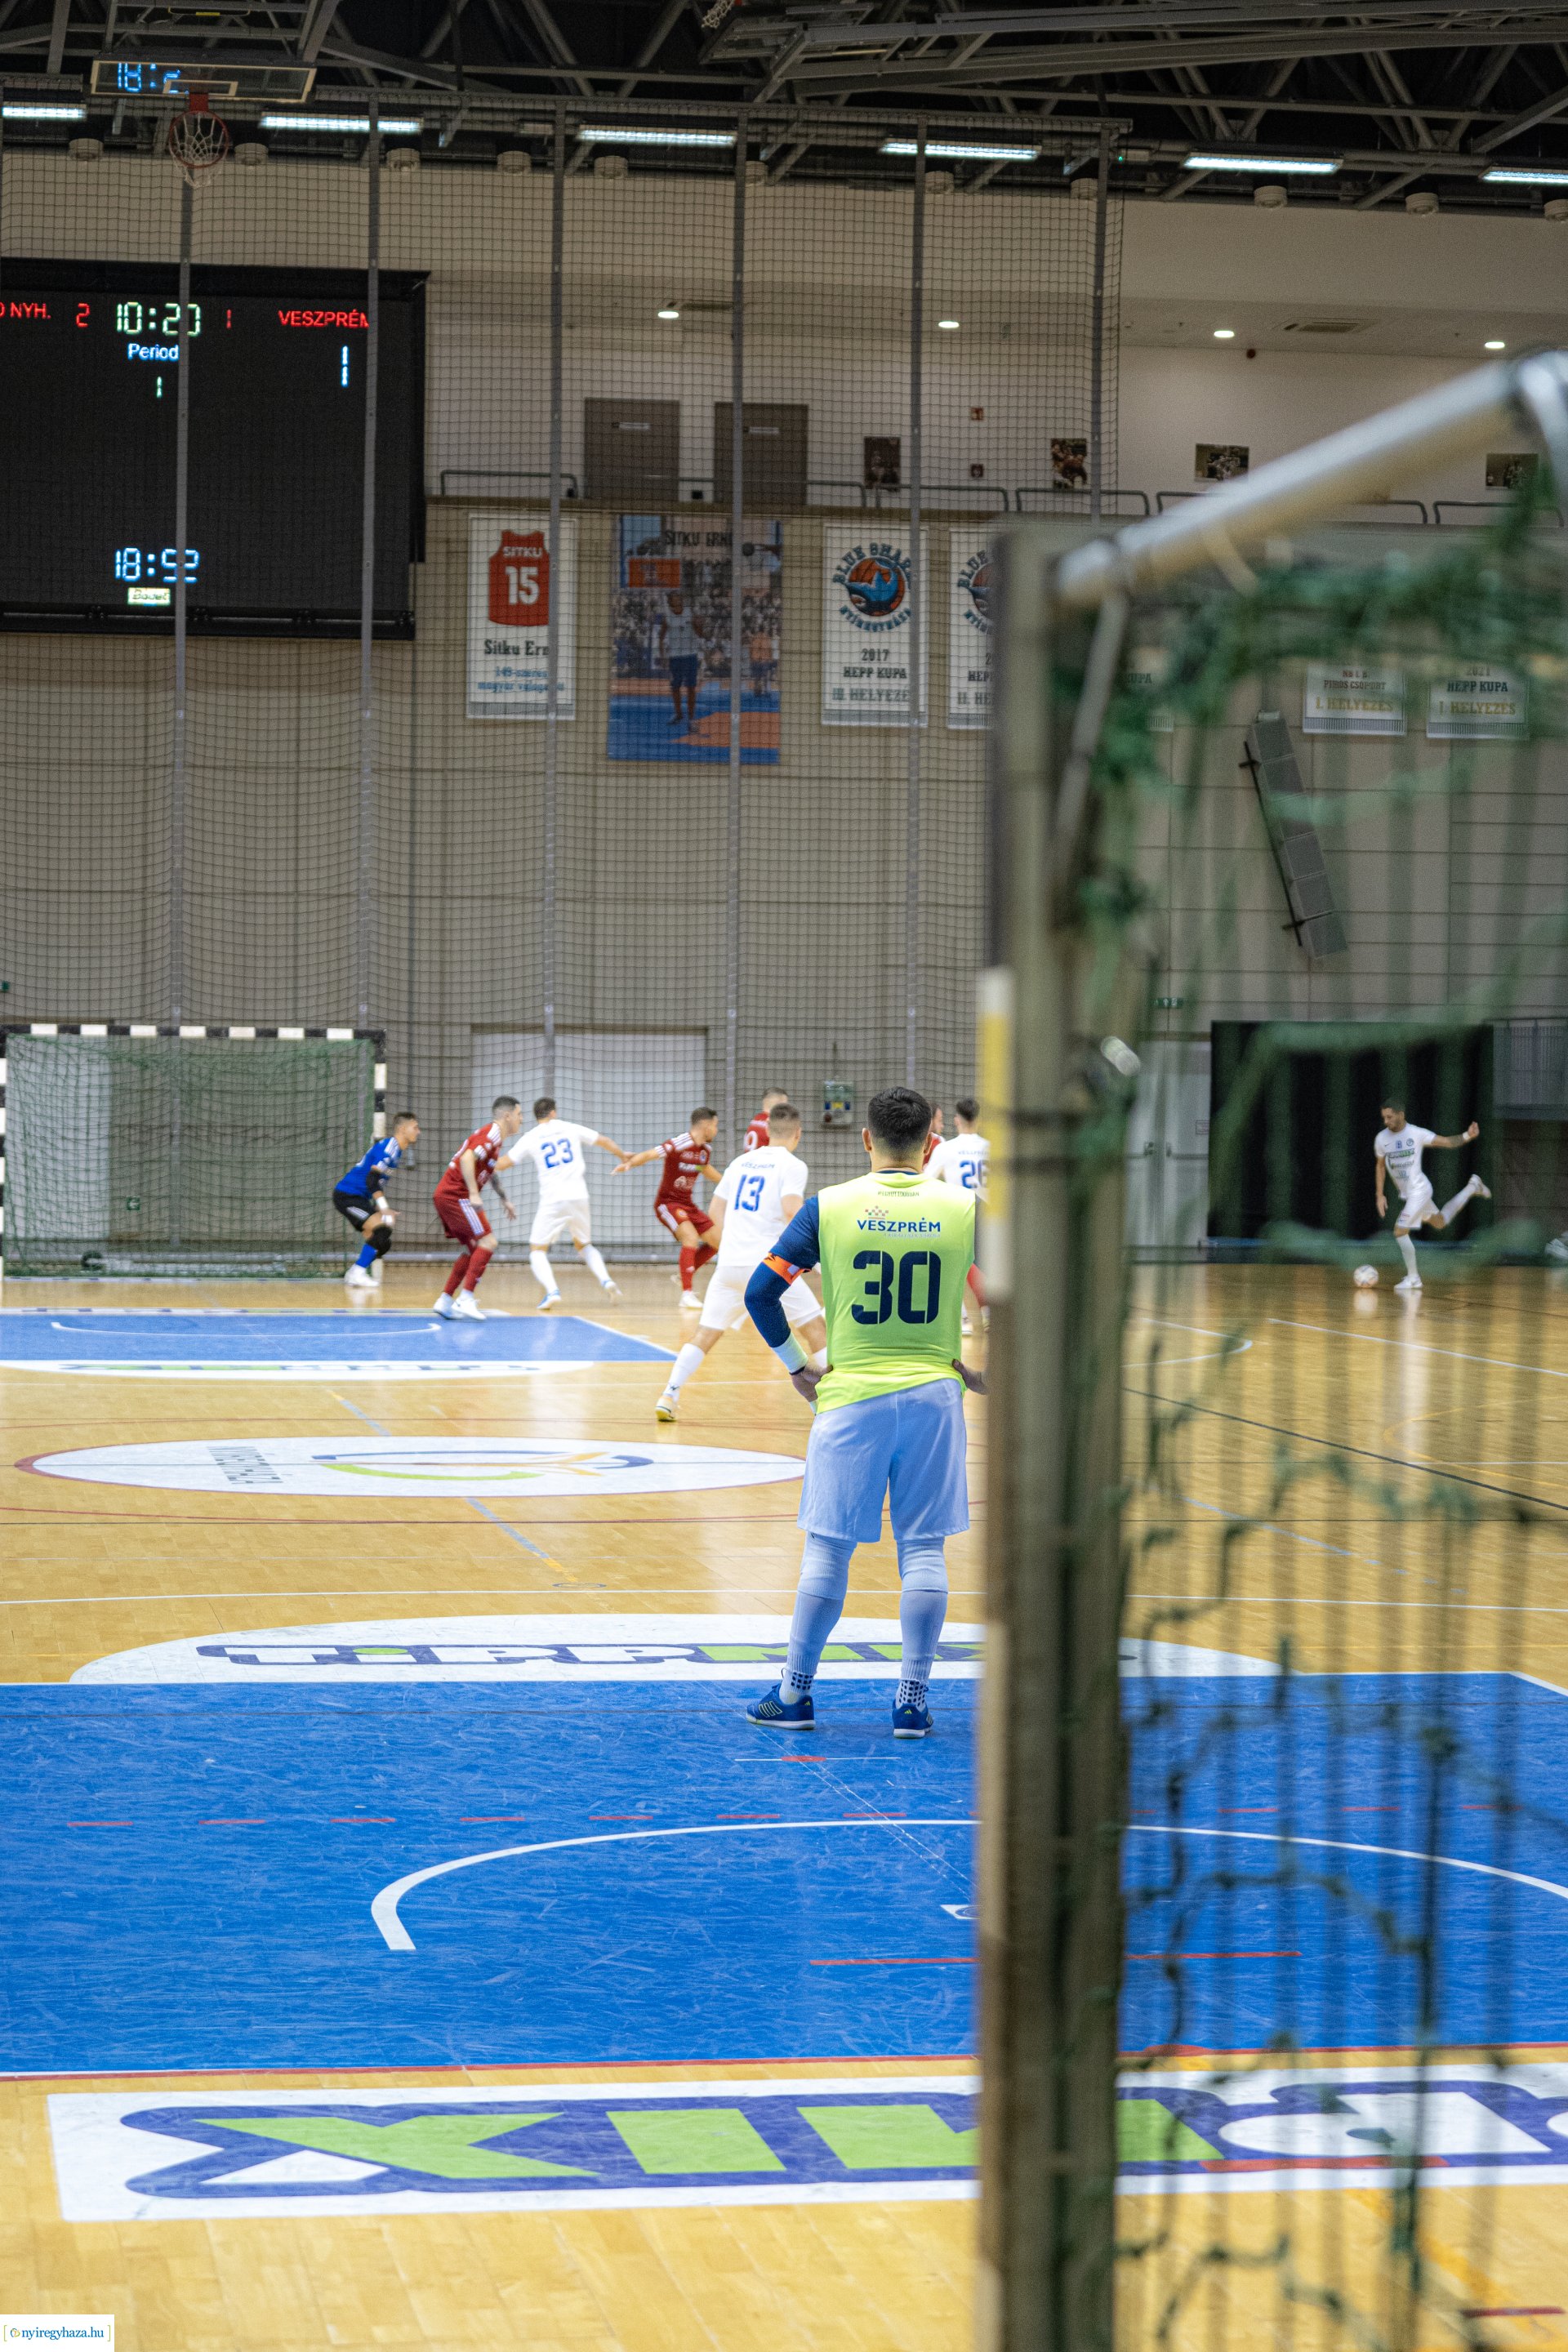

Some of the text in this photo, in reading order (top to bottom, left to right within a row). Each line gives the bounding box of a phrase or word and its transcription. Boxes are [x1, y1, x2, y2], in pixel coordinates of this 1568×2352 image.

[77, 303, 90, 327] 2
[127, 343, 180, 362] Period
[502, 546, 542, 558] SITKU
[832, 545, 866, 585] BLUE
[505, 565, 540, 605] 15
[484, 639, 549, 656] Sitku Ern
[862, 648, 890, 662] 2017
[843, 666, 907, 679] HEPP KUPA
[850, 685, 910, 702] HELYEZÉ
[1447, 680, 1508, 693] HEPP KUPA
[541, 1138, 573, 1169] 23
[735, 1174, 765, 1211] 13
[858, 1217, 941, 1232] VESZPRÉM
[852, 1250, 942, 1325] 30
